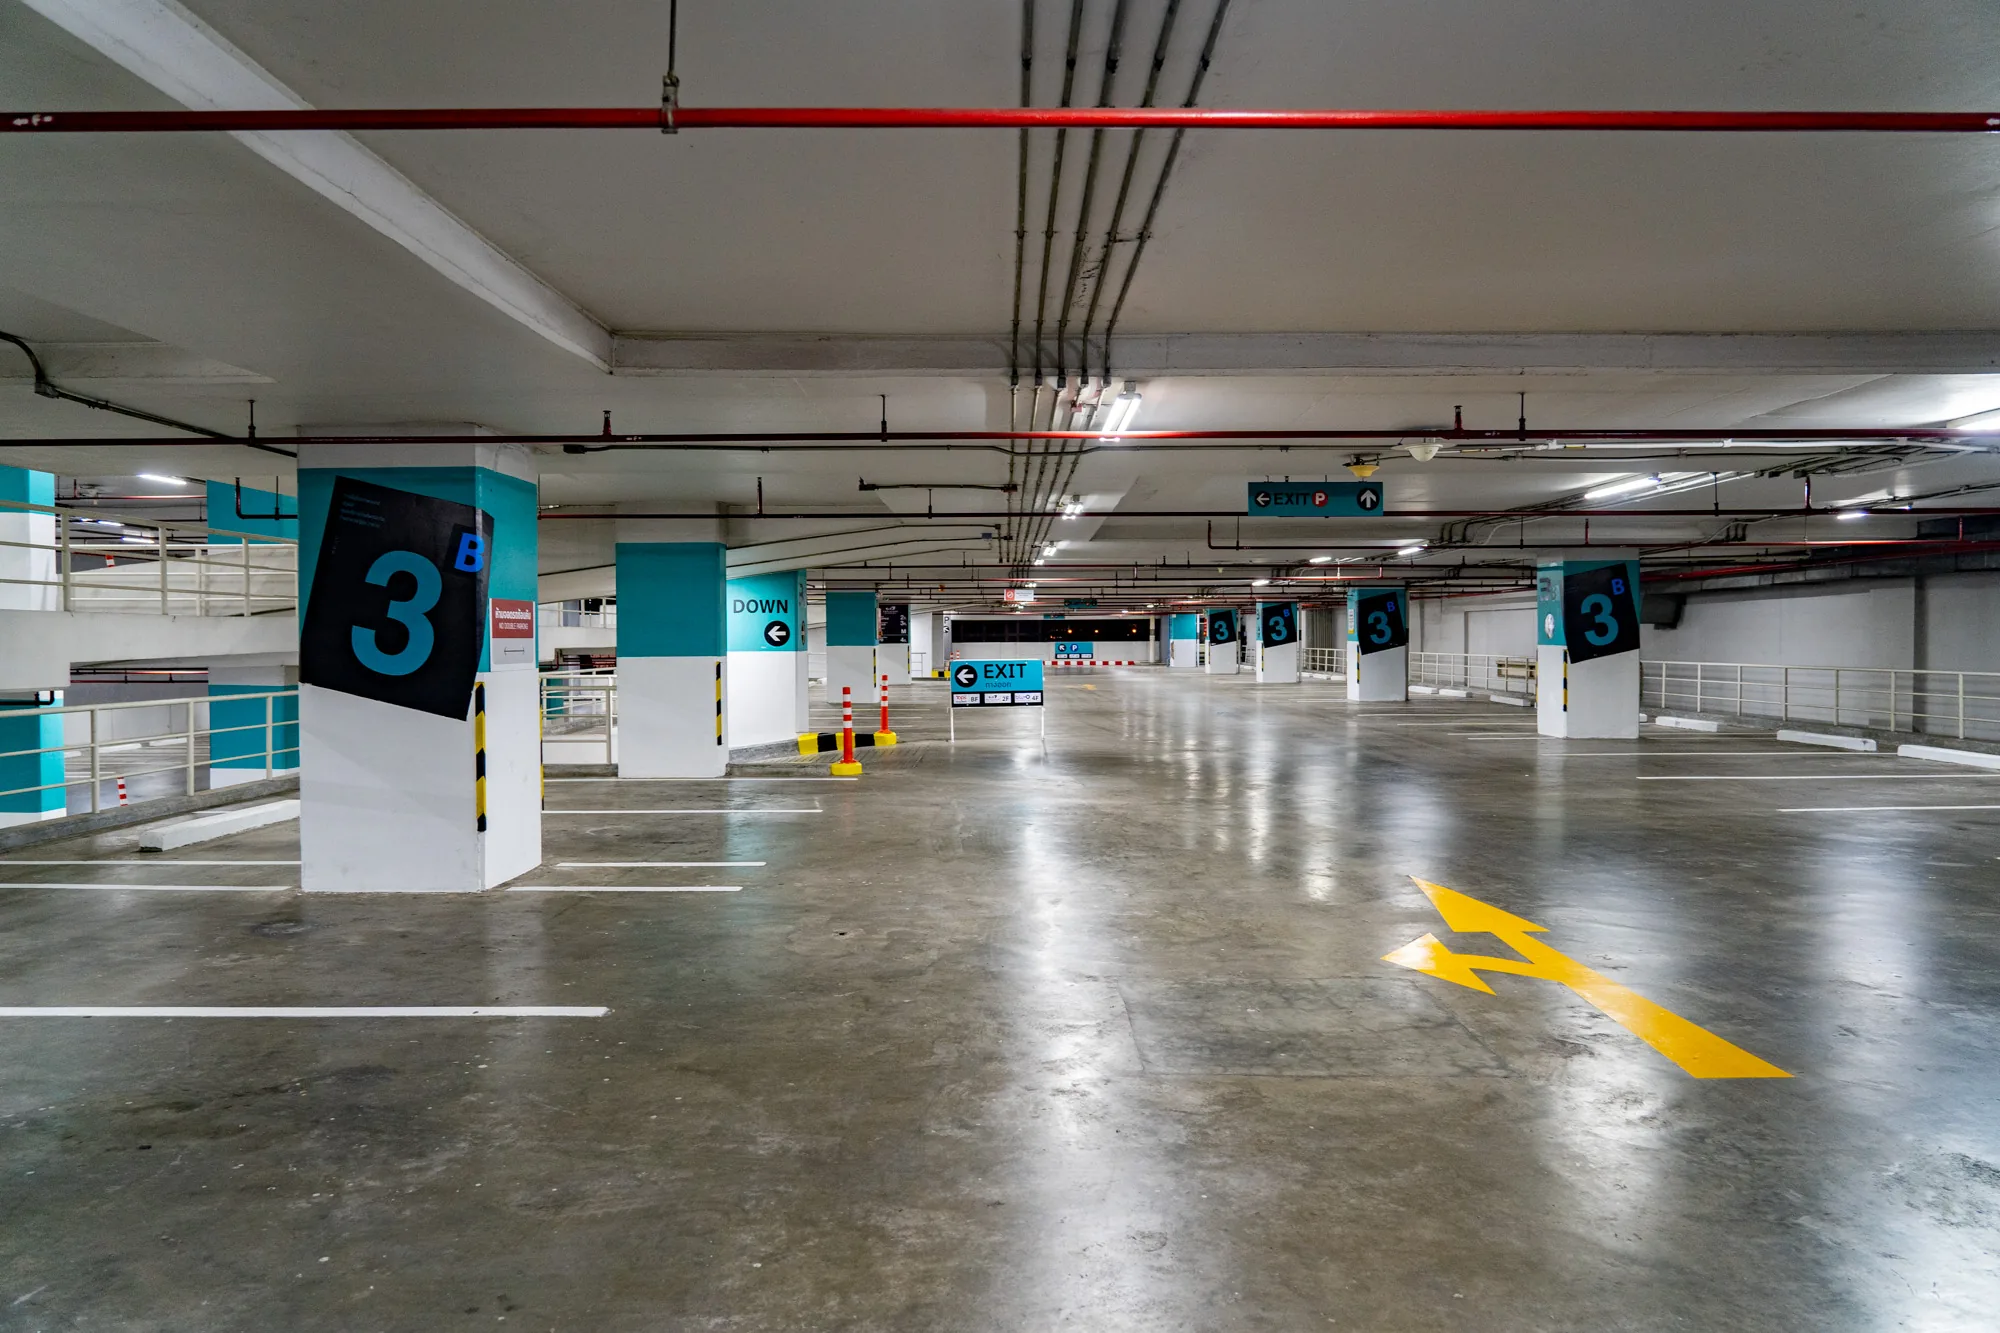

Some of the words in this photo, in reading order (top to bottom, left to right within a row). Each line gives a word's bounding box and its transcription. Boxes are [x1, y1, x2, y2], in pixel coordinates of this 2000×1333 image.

[1274, 492, 1310, 506] EXIT
[1315, 492, 1326, 505] P
[351, 550, 442, 676] 3
[454, 532, 485, 573] B
[733, 599, 788, 614] DOWN
[1581, 593, 1619, 646] 3
[1611, 578, 1625, 596] B
[1214, 620, 1229, 641] 3
[1269, 616, 1288, 641] 3
[1368, 611, 1392, 644] 3
[1386, 601, 1395, 612] B
[1071, 644, 1078, 652] P
[984, 663, 1027, 679] EXIT
